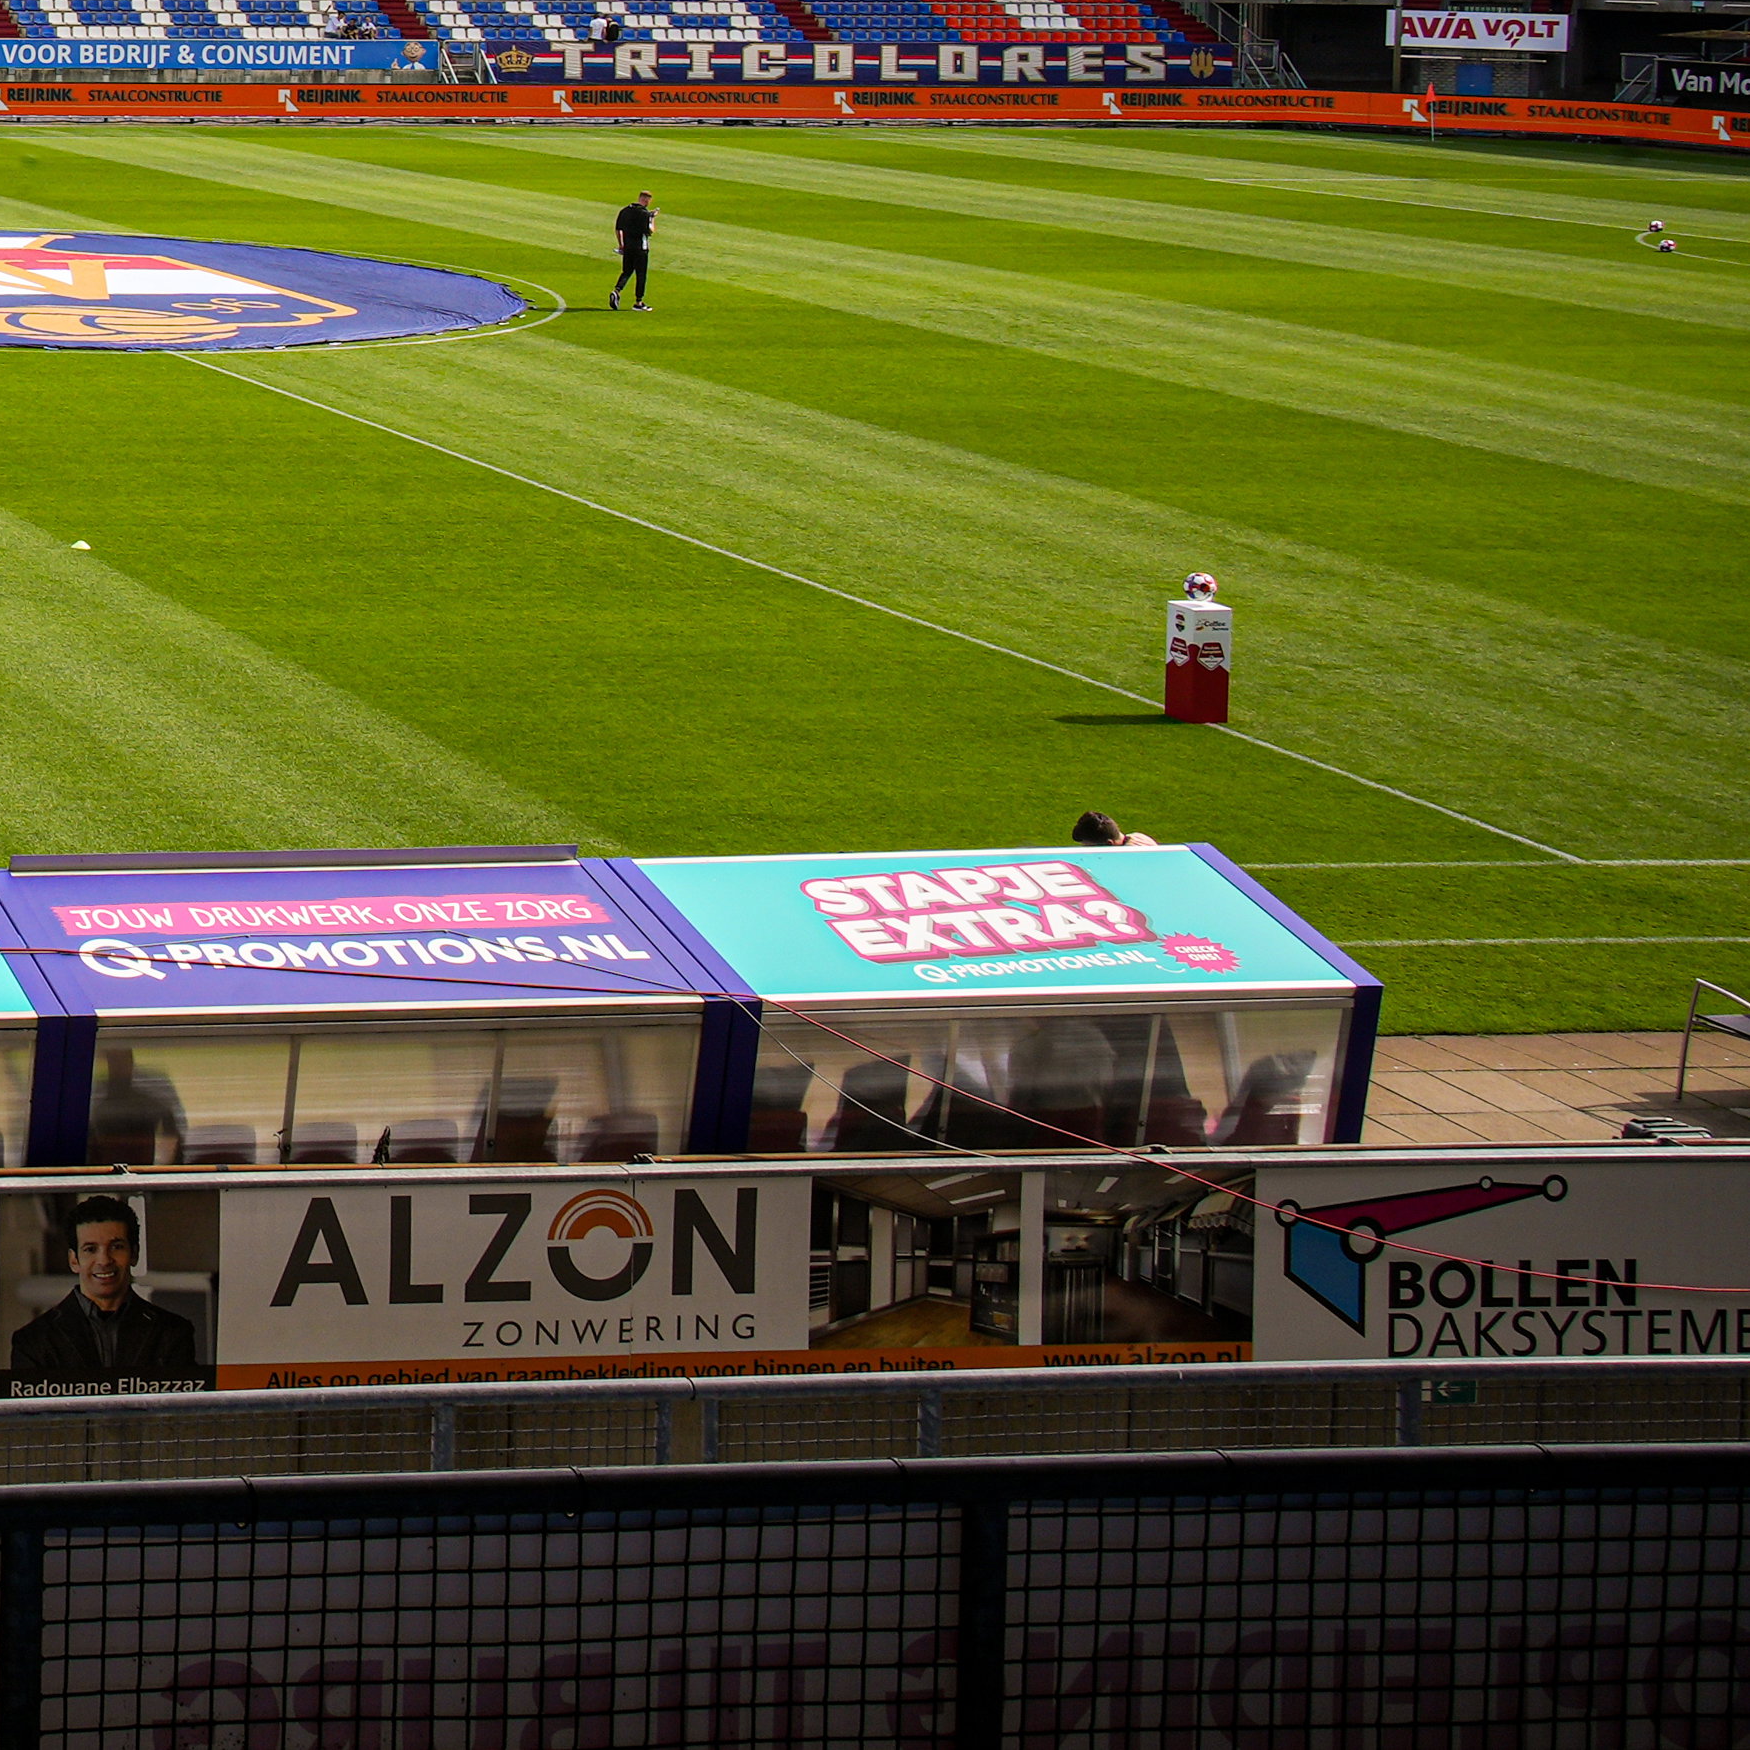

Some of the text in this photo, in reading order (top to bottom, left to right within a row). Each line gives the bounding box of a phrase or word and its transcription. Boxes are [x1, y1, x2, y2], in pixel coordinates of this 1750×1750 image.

[1, 43, 72, 64] VOOR
[79, 44, 171, 69] BEDRIJF
[178, 44, 197, 65] &
[201, 43, 356, 66] CONSUMENT
[550, 41, 1167, 84] TRICOLORES
[811, 861, 1100, 918] STAPJE
[70, 898, 594, 931] JOUW DRUKWERK, ONZE ZORG
[839, 901, 1137, 961] EXTRA?
[77, 932, 650, 981] Q-PROMOTIONS.NL
[912, 949, 1157, 984] Q-PROMOTIONS.NL
[268, 1186, 758, 1309] ALZON
[1387, 1258, 1637, 1310] BOLLEN
[462, 1313, 757, 1348] ZONWERING
[9, 1374, 207, 1398] Radouane Elbazzaz
